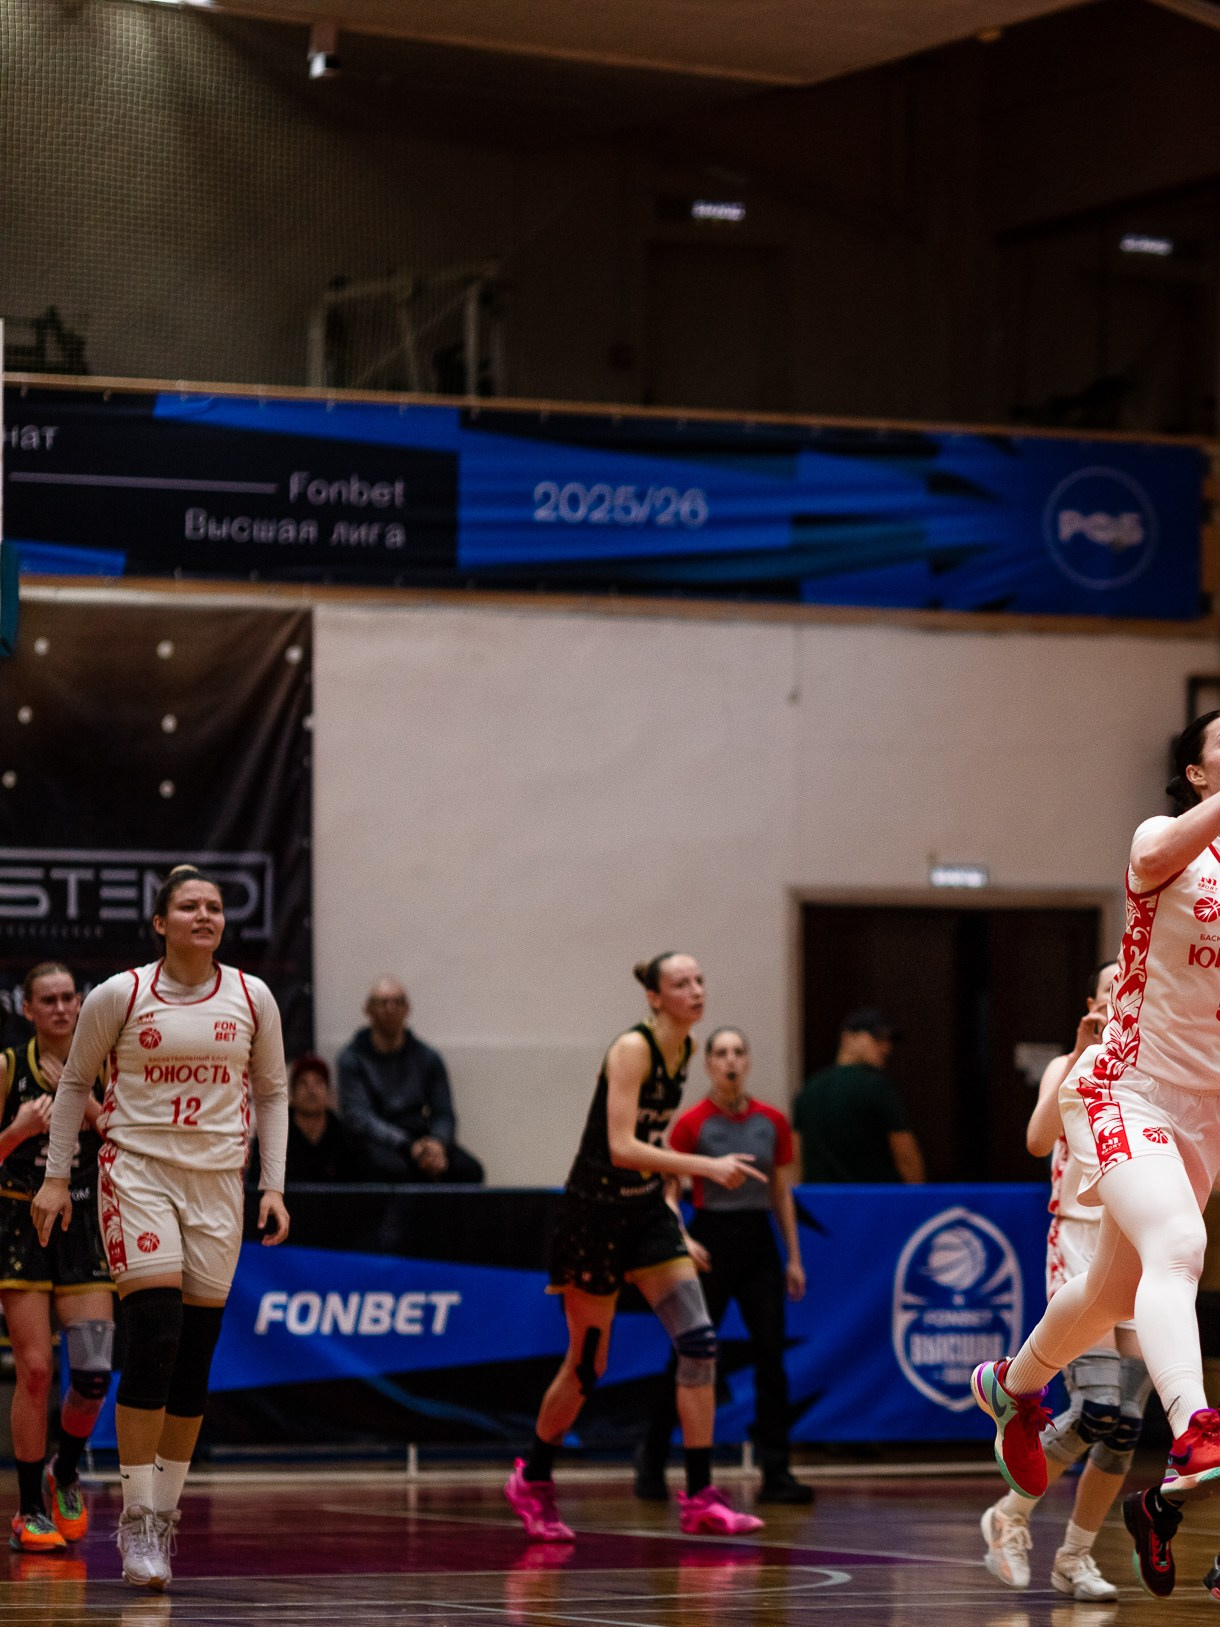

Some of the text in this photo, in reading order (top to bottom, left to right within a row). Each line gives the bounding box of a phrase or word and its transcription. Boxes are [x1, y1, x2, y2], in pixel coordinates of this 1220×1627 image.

[289, 470, 406, 508] Fonbet
[533, 481, 709, 530] 2025/26
[184, 506, 406, 550] Высшая лига
[213, 1021, 237, 1031] FON
[213, 1032, 238, 1042] BET
[143, 1064, 231, 1084] ЮНОСТЬ
[170, 1096, 202, 1126] 12
[253, 1291, 462, 1336] FONBET
